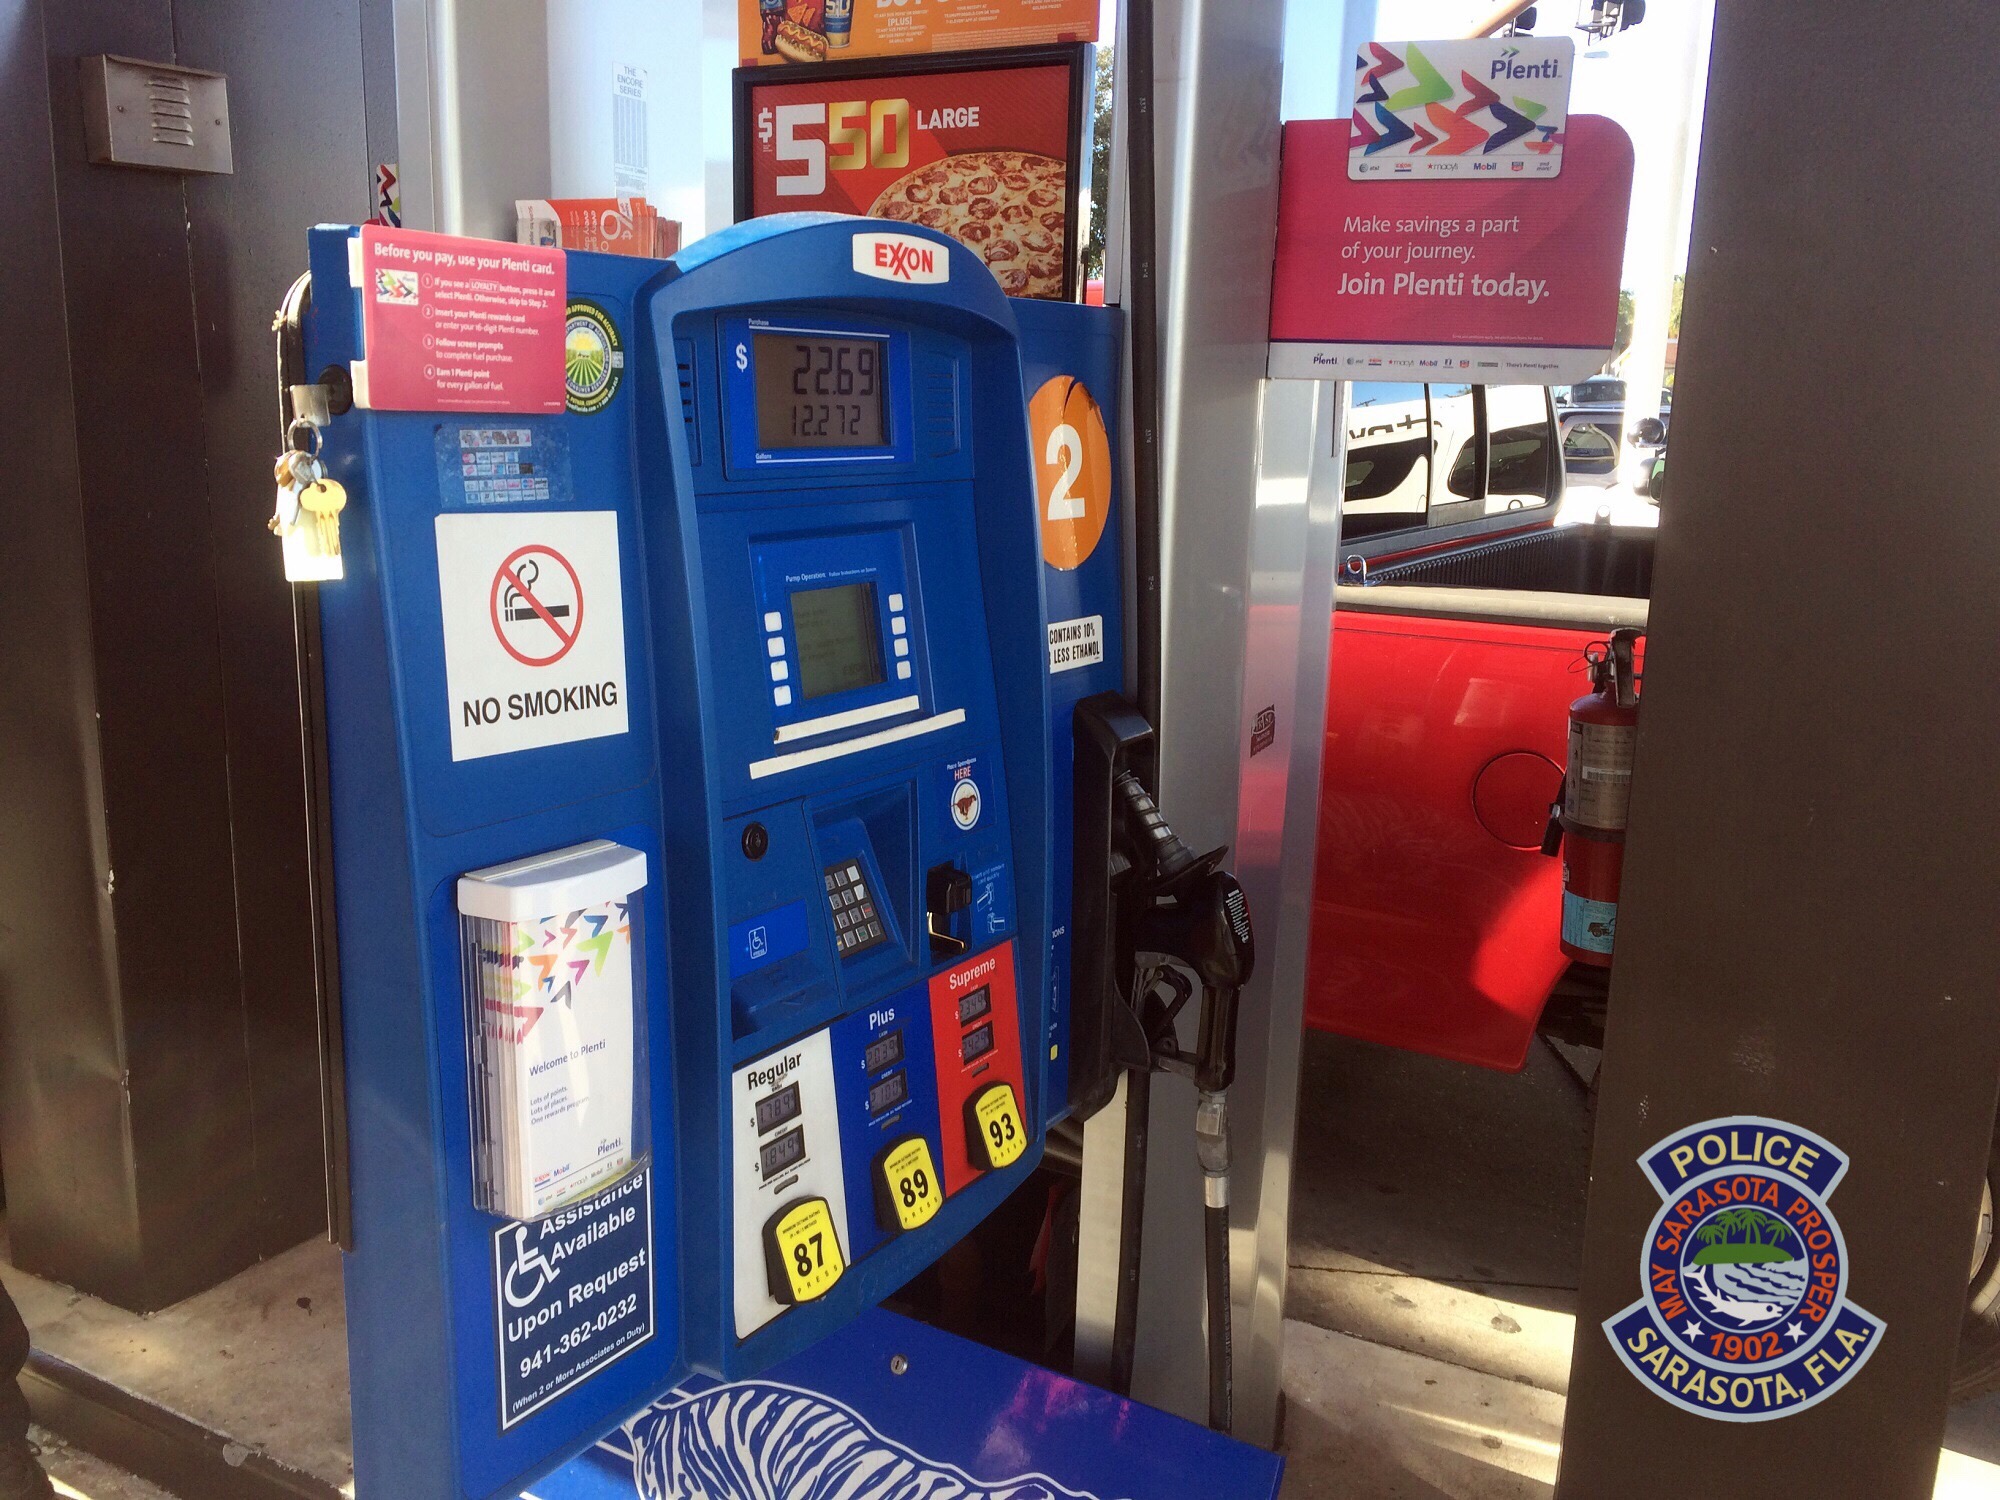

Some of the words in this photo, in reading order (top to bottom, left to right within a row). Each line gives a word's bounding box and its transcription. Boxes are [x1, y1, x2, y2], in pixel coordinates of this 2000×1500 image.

[624, 66, 637, 77] THE
[1491, 56, 1559, 80] Plenti
[617, 73, 644, 89] ENCORE
[619, 85, 642, 98] SERIES
[917, 106, 980, 130] LARGE
[1473, 162, 1498, 171] Mobil
[1343, 215, 1391, 233] Make
[1395, 216, 1460, 238] savings
[1465, 218, 1476, 232] a
[1481, 215, 1520, 238] part
[374, 242, 410, 259] Before
[412, 249, 433, 263] you
[434, 252, 456, 267] pay,
[457, 256, 475, 266] use
[477, 257, 500, 271] your
[501, 257, 530, 272] Plenti
[531, 262, 555, 275] card.
[874, 242, 934, 280] EXXON
[1341, 241, 1361, 259] of
[1362, 244, 1402, 264] your
[1404, 241, 1476, 264] journey.
[435, 291, 453, 299] select
[508, 297, 521, 307] skip
[441, 279, 453, 289] you
[471, 281, 498, 291] LOYALTY
[499, 284, 521, 294] button,
[522, 287, 538, 297] press
[544, 289, 556, 297] and
[1337, 271, 1385, 295] Join
[1393, 271, 1465, 296] Plenti
[1471, 272, 1550, 305] today.
[435, 308, 454, 317] Insert
[454, 310, 469, 319] your
[469, 310, 487, 319] Plenti
[487, 312, 512, 322] rewards
[512, 314, 526, 323] card
[571, 304, 596, 315] APPROVED
[594, 310, 604, 322] FOR
[443, 322, 459, 330] enter
[460, 323, 475, 333] your
[498, 324, 515, 334] Plenti
[515, 326, 539, 336] number.
[435, 337, 457, 347] Follow
[457, 340, 477, 349] screen
[477, 341, 504, 351] prompts
[443, 351, 473, 362] complete
[473, 351, 485, 360] fuel
[485, 352, 514, 363] purchase.
[735, 342, 748, 372] $
[1313, 356, 1338, 364] Plenti
[1419, 359, 1438, 367] Mobil
[436, 367, 451, 377] Earn
[455, 368, 473, 378] Plenti
[473, 370, 490, 379] point
[793, 345, 874, 395] 22.69
[436, 379, 446, 388] for
[446, 381, 464, 391] every
[464, 381, 483, 392] gallon
[491, 381, 504, 391] fuel.
[791, 404, 861, 437] 12.272
[1045, 423, 1086, 521] 2
[785, 575, 801, 583] Pump
[1049, 624, 1082, 645] CONTAINS
[1083, 622, 1096, 638] 10%
[1054, 646, 1070, 664] LESS
[1072, 641, 1100, 661] ETHANOL
[463, 697, 501, 728] NO
[507, 681, 618, 721] SMOKING
[954, 765, 972, 781] HERE
[949, 957, 996, 990] Supreme
[869, 1007, 895, 1031] Plus
[529, 1055, 568, 1077] Welcome
[570, 1050, 579, 1060] to
[580, 1038, 606, 1056] Plenti
[861, 1060, 865, 1069] $
[747, 1052, 802, 1091] Regular
[530, 1096, 543, 1106] Lots
[543, 1093, 550, 1101] of
[550, 1085, 568, 1099] points.
[530, 1105, 543, 1116] Lots
[543, 1102, 550, 1110] of
[550, 1096, 568, 1109] places.
[864, 1100, 870, 1110] $
[531, 1115, 544, 1125] One
[544, 1105, 566, 1119] rewards
[750, 1117, 755, 1128] $
[989, 1112, 1015, 1148] 93
[597, 1137, 622, 1156] Plenti
[553, 1163, 570, 1177] Mobil
[754, 1162, 760, 1173] $
[900, 1168, 929, 1208] 89
[550, 1206, 636, 1265] Available
[794, 1231, 824, 1277] 87
[797, 1264, 838, 1294] PRESS
[508, 1299, 562, 1342] Upon
[569, 1247, 646, 1308] Request
[520, 1293, 638, 1379] 941-362-0232
[512, 1390, 538, 1413] (When
[538, 1385, 544, 1395] 2
[545, 1380, 554, 1391] or
[555, 1368, 574, 1385] More
[575, 1342, 615, 1373] Associates
[616, 1336, 626, 1346] on
[626, 1322, 645, 1340] Duty)
